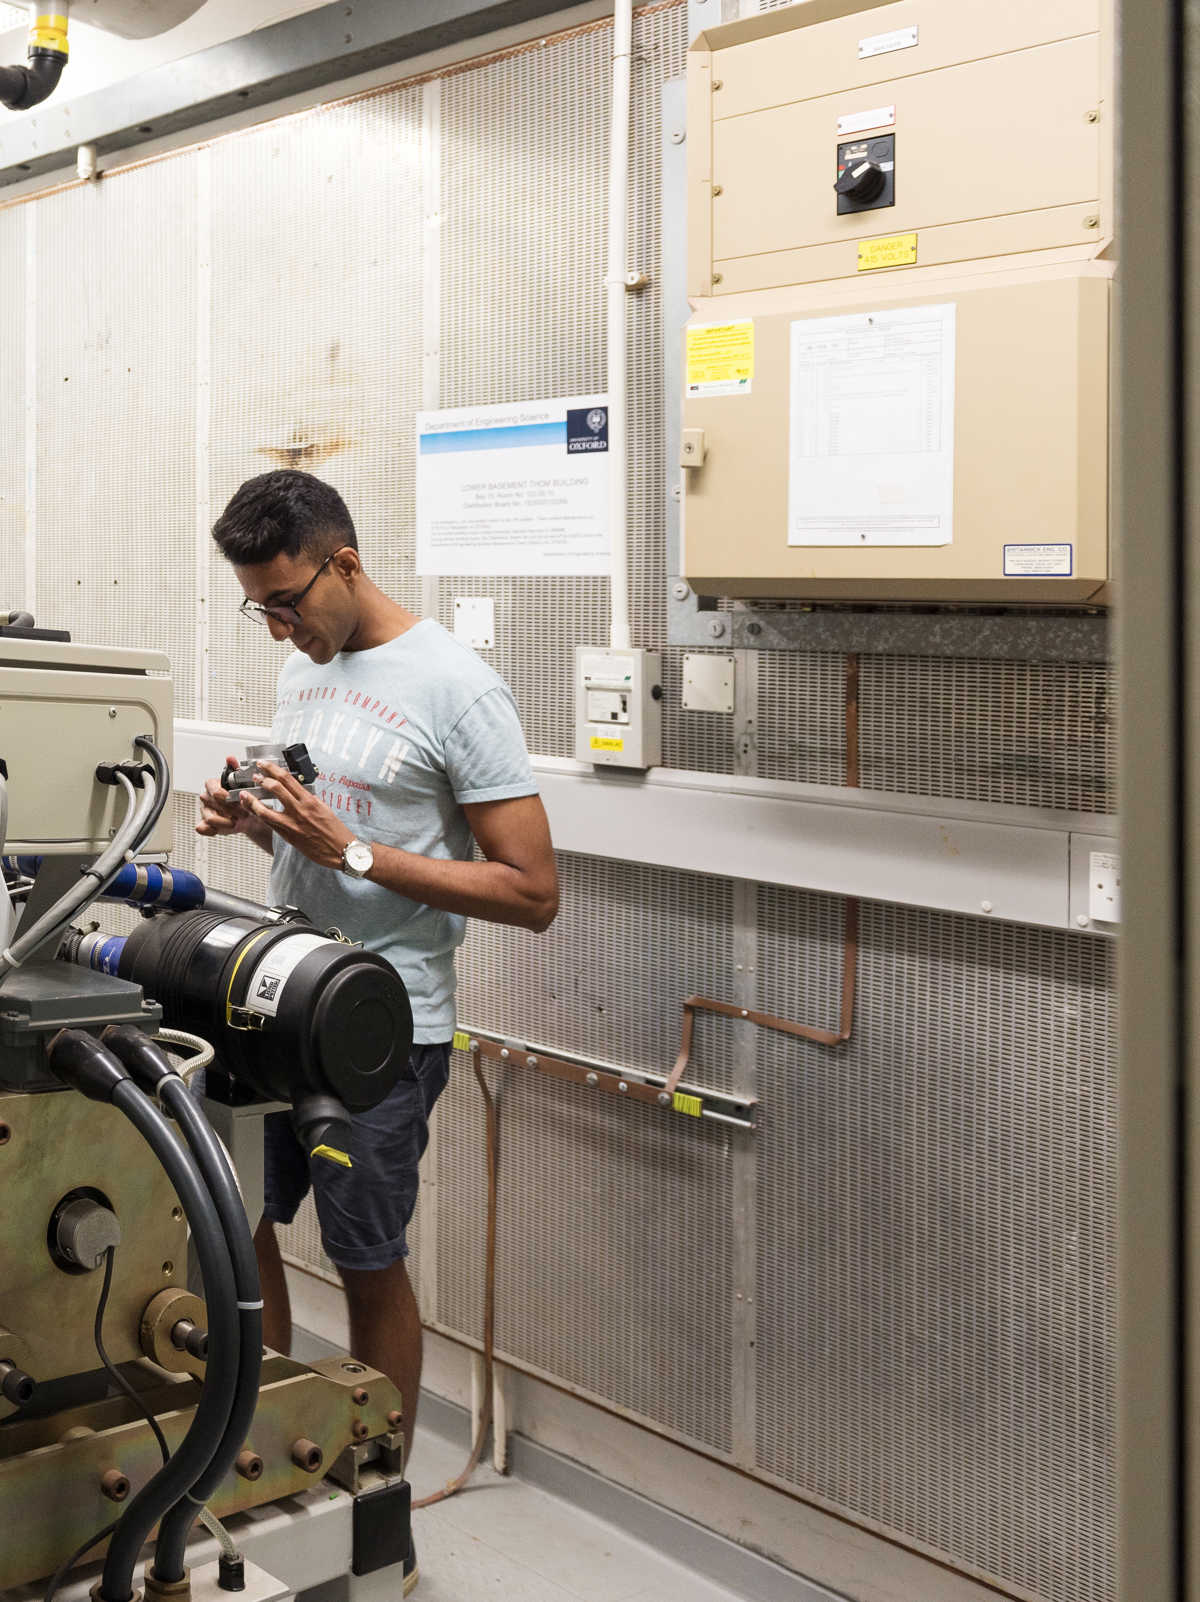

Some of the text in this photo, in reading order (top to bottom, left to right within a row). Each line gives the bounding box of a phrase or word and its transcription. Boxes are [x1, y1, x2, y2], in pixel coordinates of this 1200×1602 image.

[425, 421, 465, 431] Department
[476, 416, 518, 427] Engineering
[520, 412, 549, 422] Science
[569, 441, 607, 451] OXFORD
[298, 686, 337, 703] MOTOR
[343, 688, 409, 730] COMPANY
[321, 789, 371, 816] STREET
